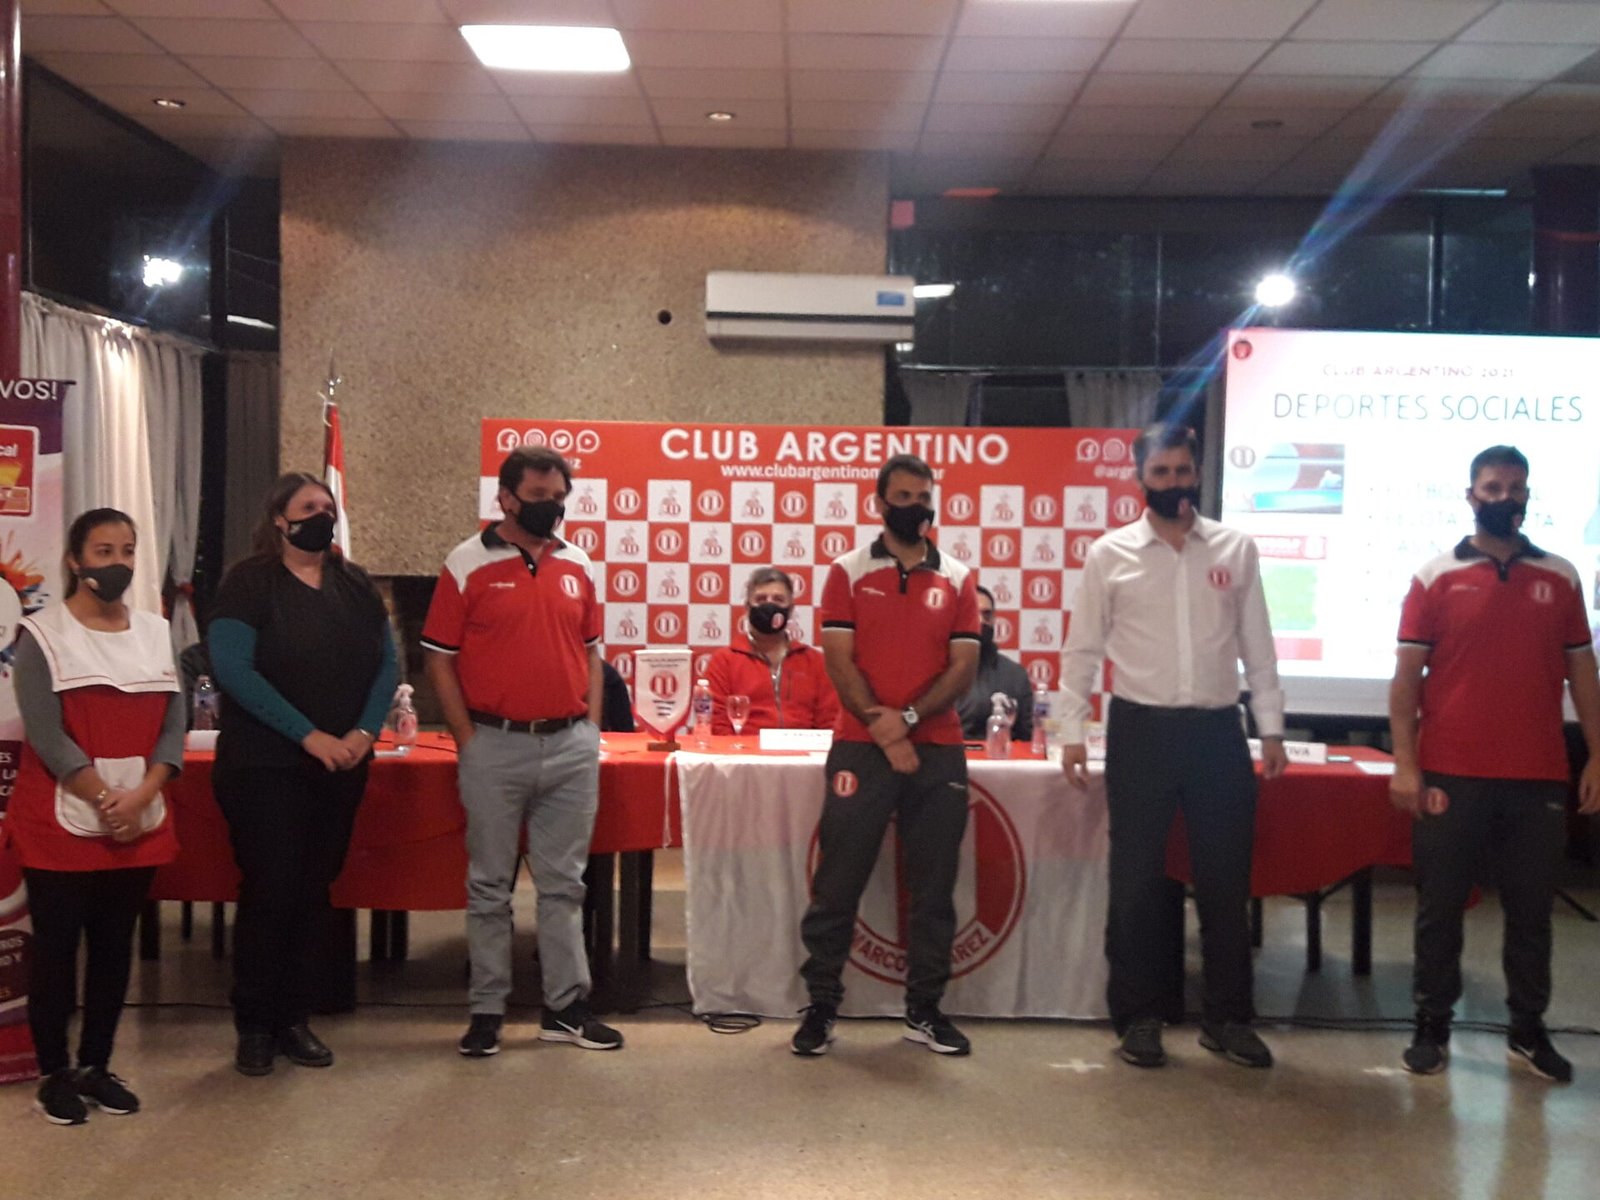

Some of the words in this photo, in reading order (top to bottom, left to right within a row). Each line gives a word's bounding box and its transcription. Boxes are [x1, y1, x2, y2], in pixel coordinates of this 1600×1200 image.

[1373, 365, 1473, 377] ARGENTINO
[1274, 393, 1428, 420] DEPORTES
[1441, 395, 1583, 422] SOCIALES
[660, 428, 759, 461] CLUB
[775, 430, 1009, 466] ARGENTINO
